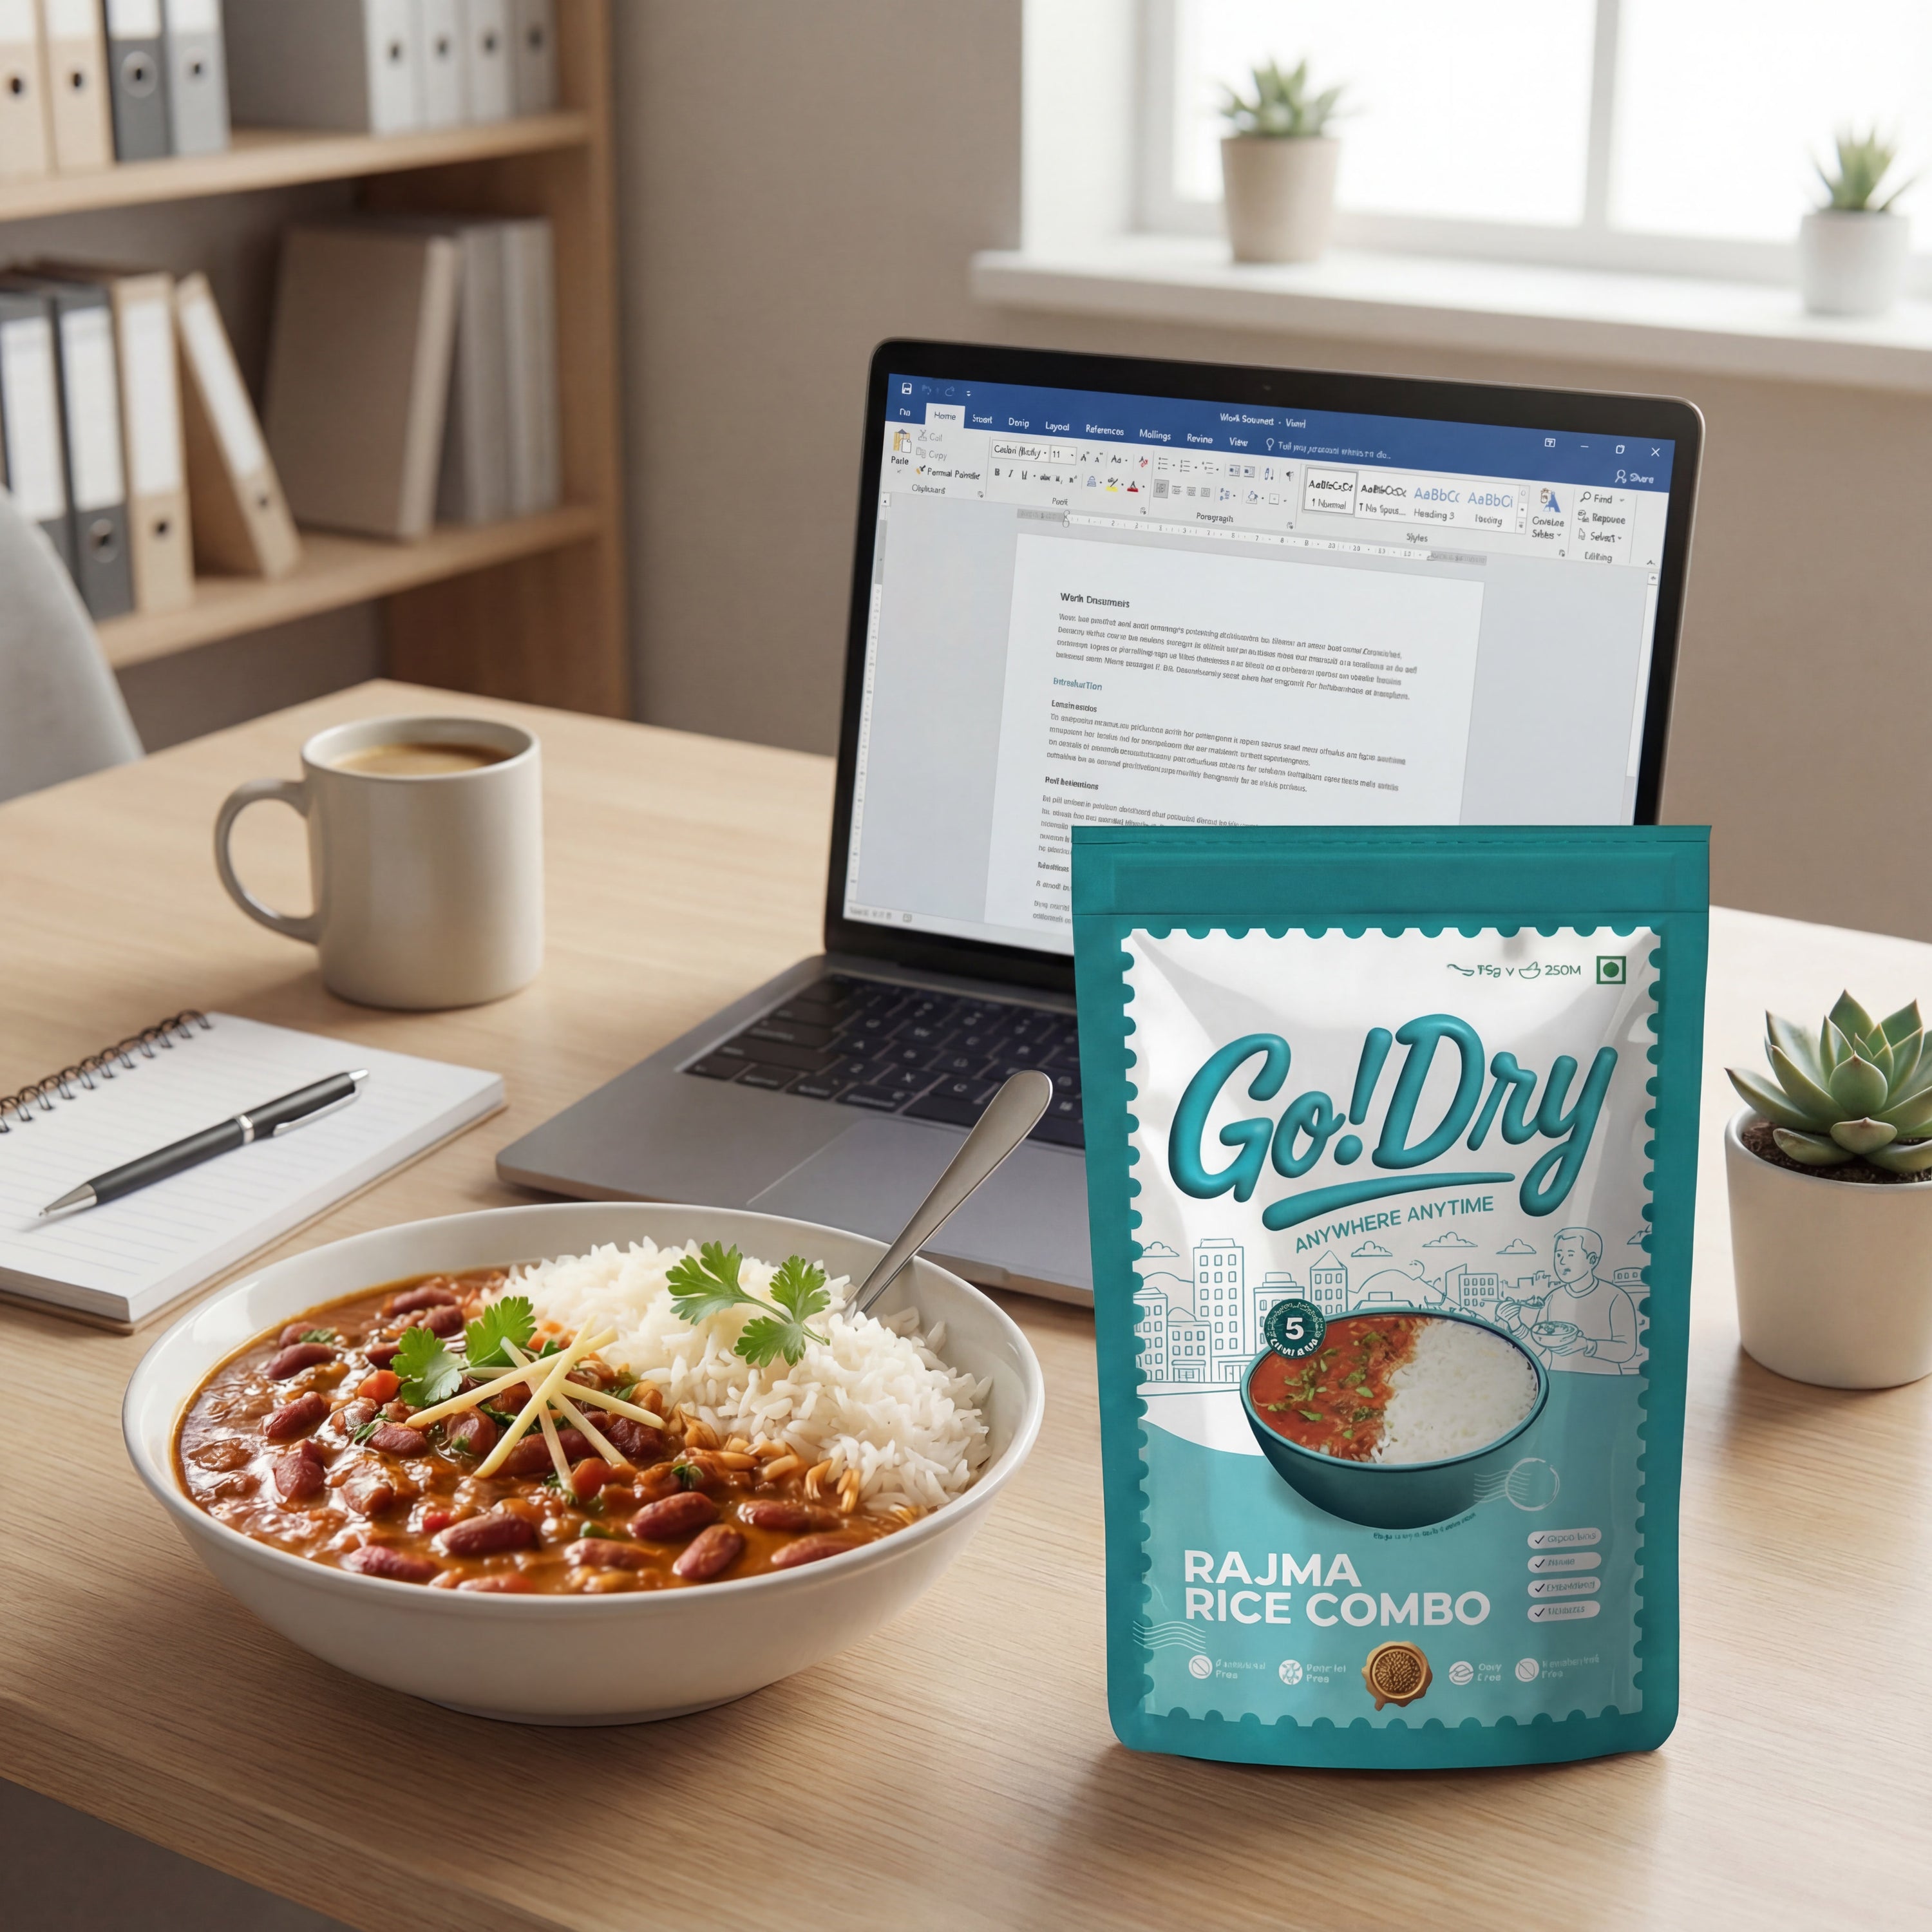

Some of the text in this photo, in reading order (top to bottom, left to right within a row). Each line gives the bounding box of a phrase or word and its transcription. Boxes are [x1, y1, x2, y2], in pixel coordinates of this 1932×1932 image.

[934, 412, 956, 421] Home
[1086, 424, 1124, 436] References
[1296, 1195, 1494, 1254] ANYWHERE ANYTIME
[1285, 1317, 1304, 1340] 5
[1184, 1549, 1362, 1587] RAJMA
[1185, 1587, 1491, 1627] RICE COMBO
